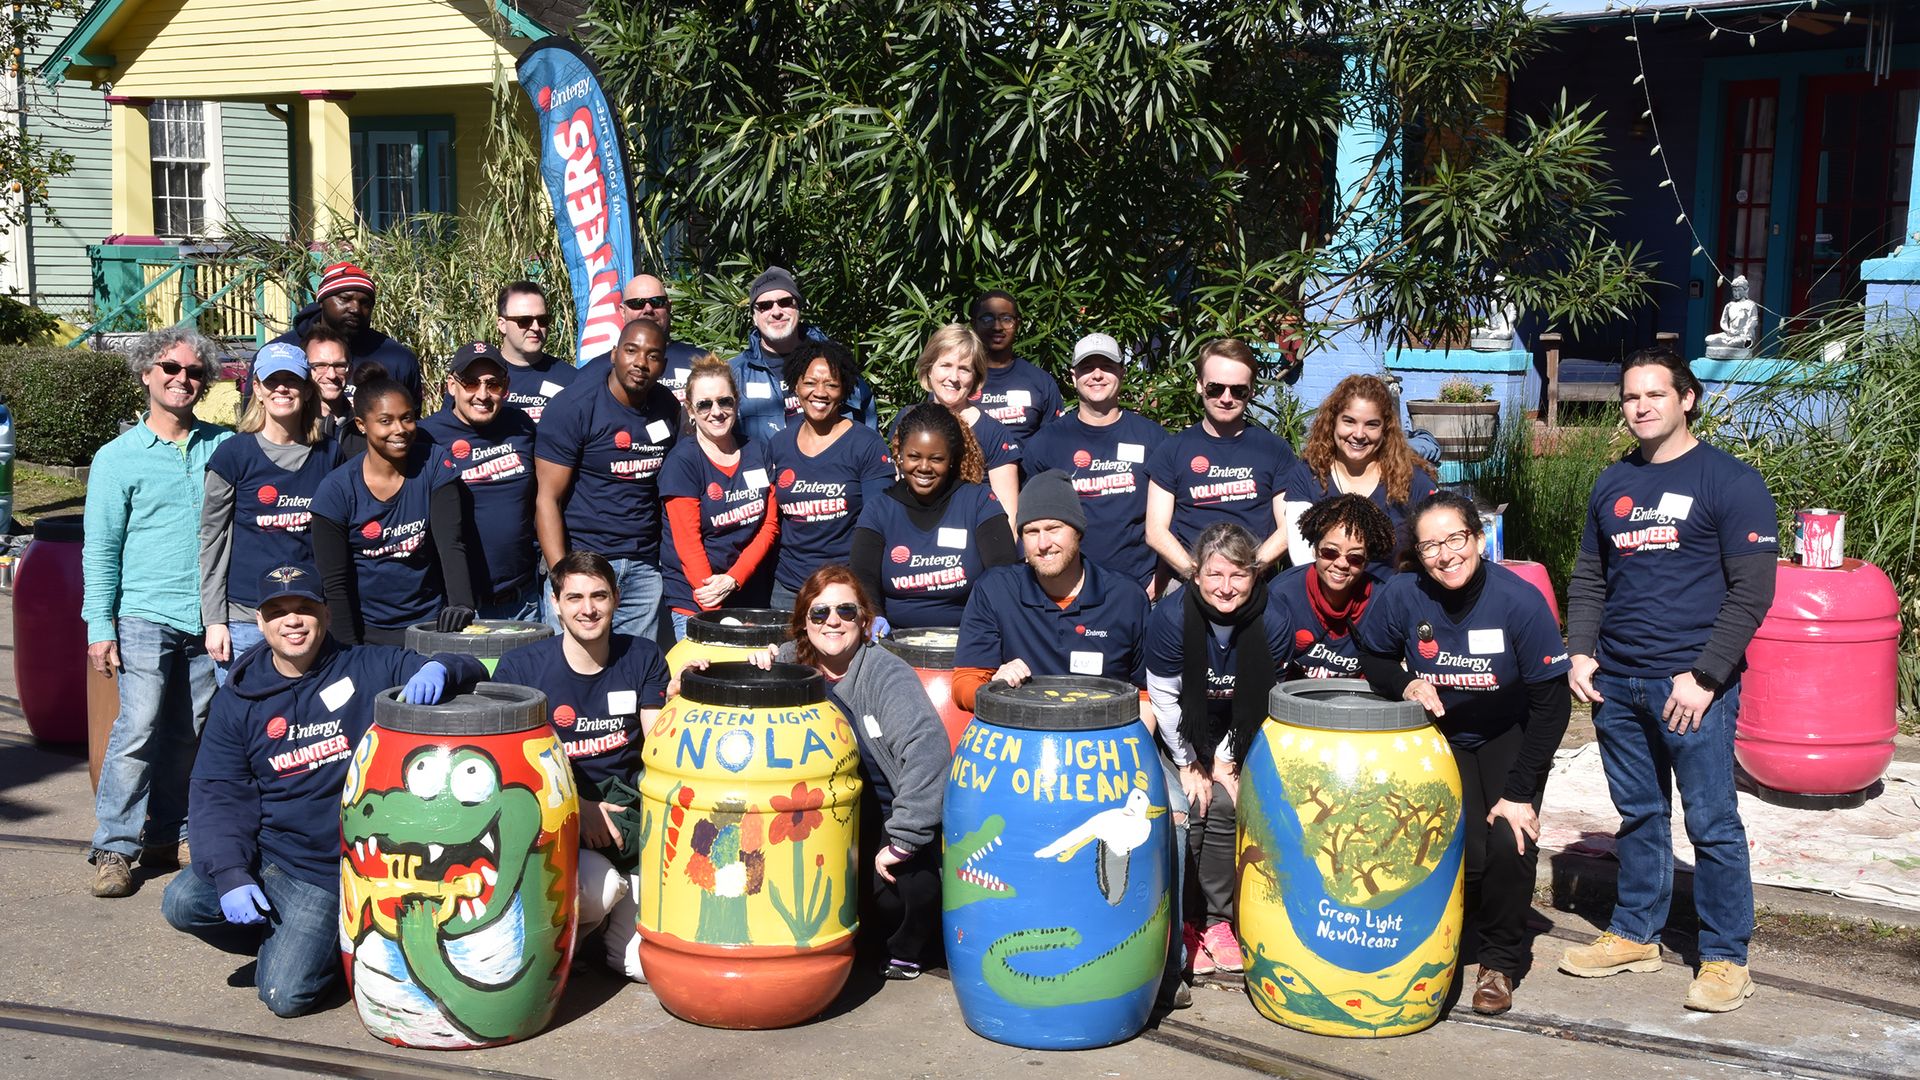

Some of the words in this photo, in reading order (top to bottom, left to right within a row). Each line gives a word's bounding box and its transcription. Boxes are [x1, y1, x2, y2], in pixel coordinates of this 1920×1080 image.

[604, 140, 618, 189] POWER
[612, 194, 621, 216] WE
[1072, 472, 1136, 493] VOLUNTEER
[1189, 479, 1257, 500] VOLUNTEER
[710, 498, 765, 528] VOLUNTEER
[779, 497, 848, 516] VOLUNTEER
[1611, 525, 1679, 550] VOLUNTEER
[891, 566, 967, 590] VOLUNTEER
[937, 583, 956, 591] Power
[1307, 643, 1361, 671] Enterg
[683, 709, 755, 726] GREEN
[767, 708, 821, 725] LIGHT
[268, 734, 350, 772] VOLUNTEER
[562, 730, 628, 757] OLUNTEER
[676, 727, 834, 773] NOLA
[960, 725, 1023, 764] REEN
[1042, 737, 1140, 771] IGHT
[950, 754, 997, 793] NEW
[1012, 769, 1149, 803] ORLEANS
[1318, 899, 1360, 926] Green
[1366, 909, 1404, 934] Light
